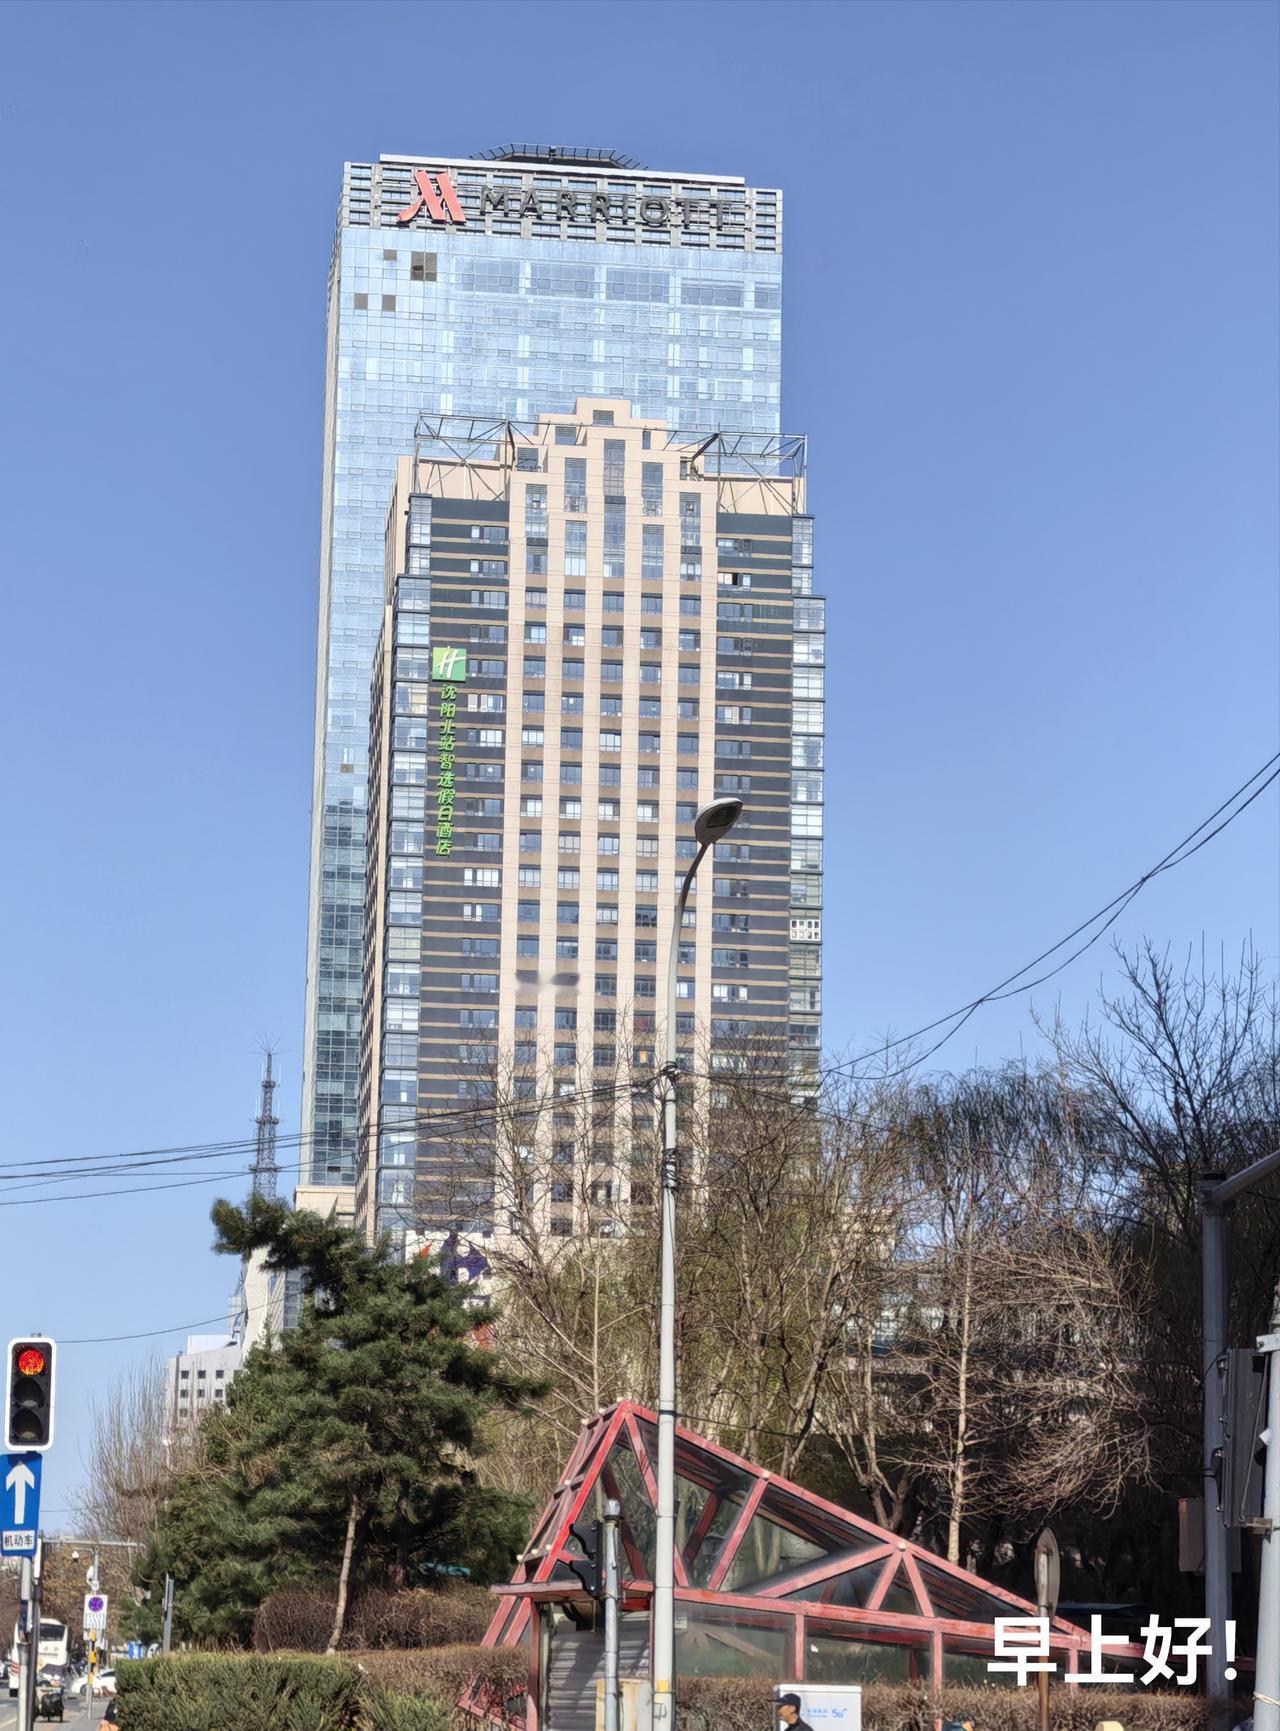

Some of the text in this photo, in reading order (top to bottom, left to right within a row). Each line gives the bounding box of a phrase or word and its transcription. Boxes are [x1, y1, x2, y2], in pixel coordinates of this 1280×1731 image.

[479, 184, 733, 232] MARRIOTT
[436, 684, 457, 857] 沈阳北站智选假日酒店
[4, 1534, 33, 1547] 机动车
